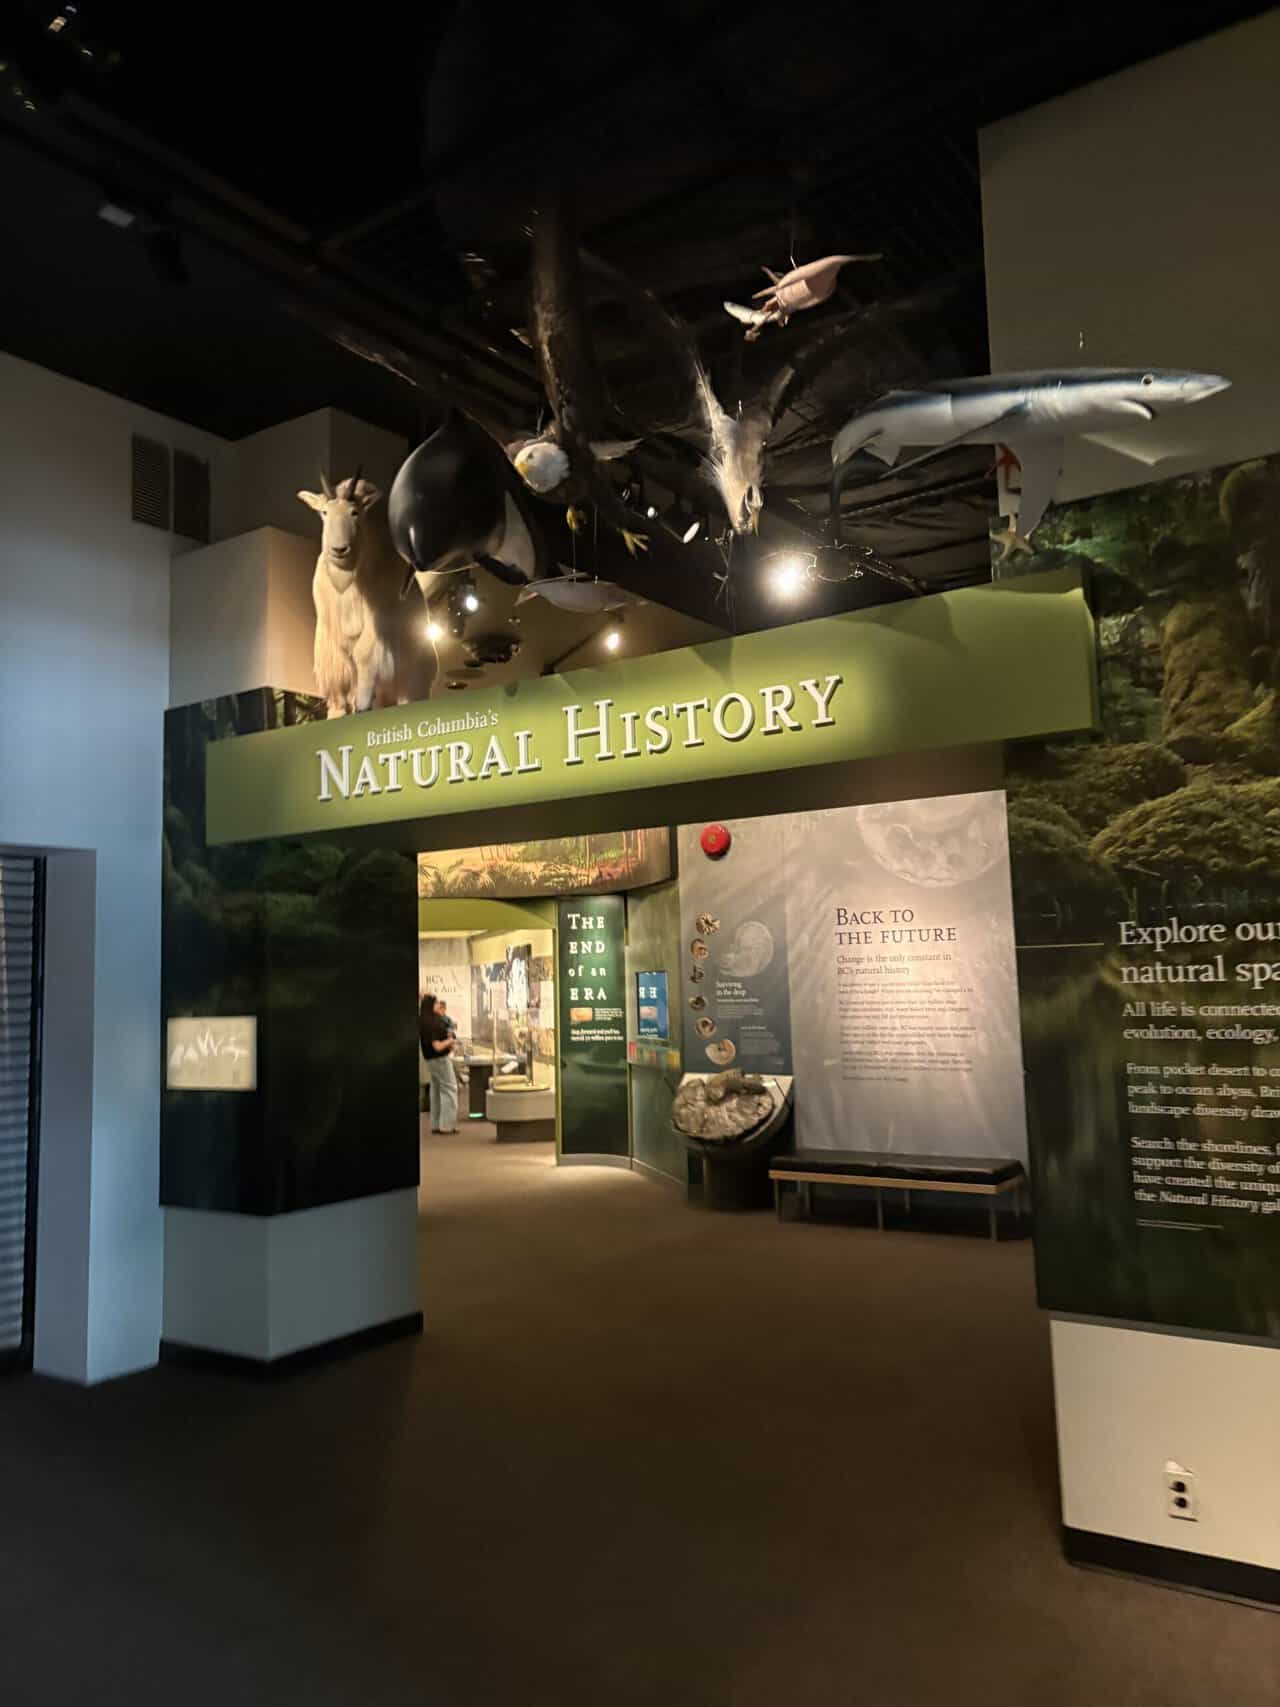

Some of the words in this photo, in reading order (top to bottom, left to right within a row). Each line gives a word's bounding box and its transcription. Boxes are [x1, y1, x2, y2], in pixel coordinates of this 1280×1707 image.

[367, 723, 412, 747] British
[417, 709, 499, 738] Columbia's
[316, 730, 542, 802] NATURAL
[562, 674, 843, 766] HISTORY
[567, 913, 605, 930] THE
[836, 907, 884, 926] BACK
[889, 908, 915, 923] TO
[835, 930, 873, 945] THE
[880, 927, 957, 944] FUTURE
[1118, 917, 1228, 952] Explore
[568, 941, 606, 954] END
[836, 954, 864, 965] Change
[866, 954, 873, 963] is
[875, 953, 888, 963] the
[907, 952, 941, 962] constant
[943, 951, 952, 961] in
[568, 964, 584, 977] of
[590, 966, 607, 977] an
[855, 965, 883, 975] natural
[884, 964, 910, 976] history
[1120, 954, 1229, 984] natural
[570, 987, 607, 1001] ERA
[1121, 1002, 1147, 1017] All
[1150, 1001, 1178, 1017] life
[1181, 1002, 1196, 1017] is
[1208, 1063, 1250, 1076] desert
[1252, 1065, 1267, 1077] to
[1128, 1101, 1192, 1119] landscape
[1192, 1103, 1248, 1120] diversity
[1130, 1136, 1175, 1150] Search
[1176, 1138, 1200, 1151] the
[1183, 1156, 1207, 1169] the
[1207, 1157, 1265, 1176] diversity
[1213, 1176, 1239, 1189] the
[1134, 1189, 1158, 1202] the
[1160, 1191, 1209, 1205] Natural
[1210, 1194, 1260, 1213] History
